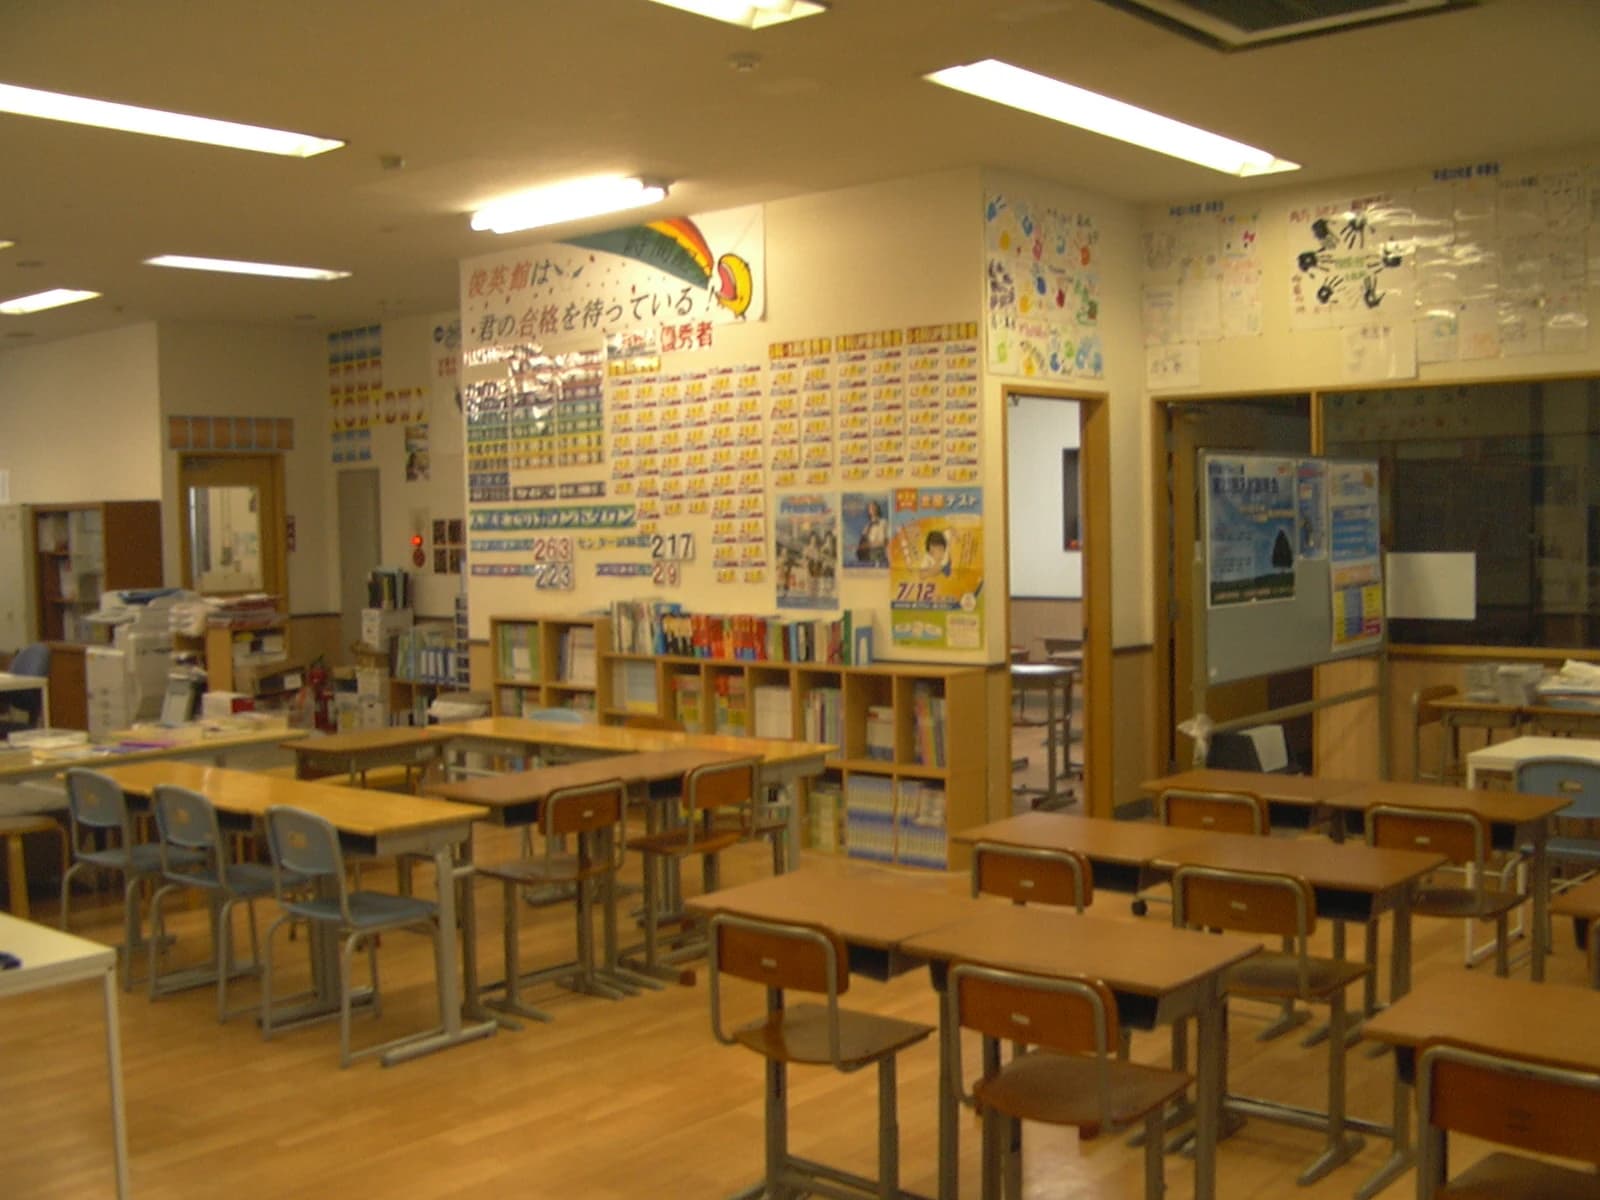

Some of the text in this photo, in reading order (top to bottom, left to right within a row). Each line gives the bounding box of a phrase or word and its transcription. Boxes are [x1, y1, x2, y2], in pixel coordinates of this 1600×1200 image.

[534, 538, 570, 562] 263
[651, 533, 692, 559] 217
[653, 562, 677, 585] 29
